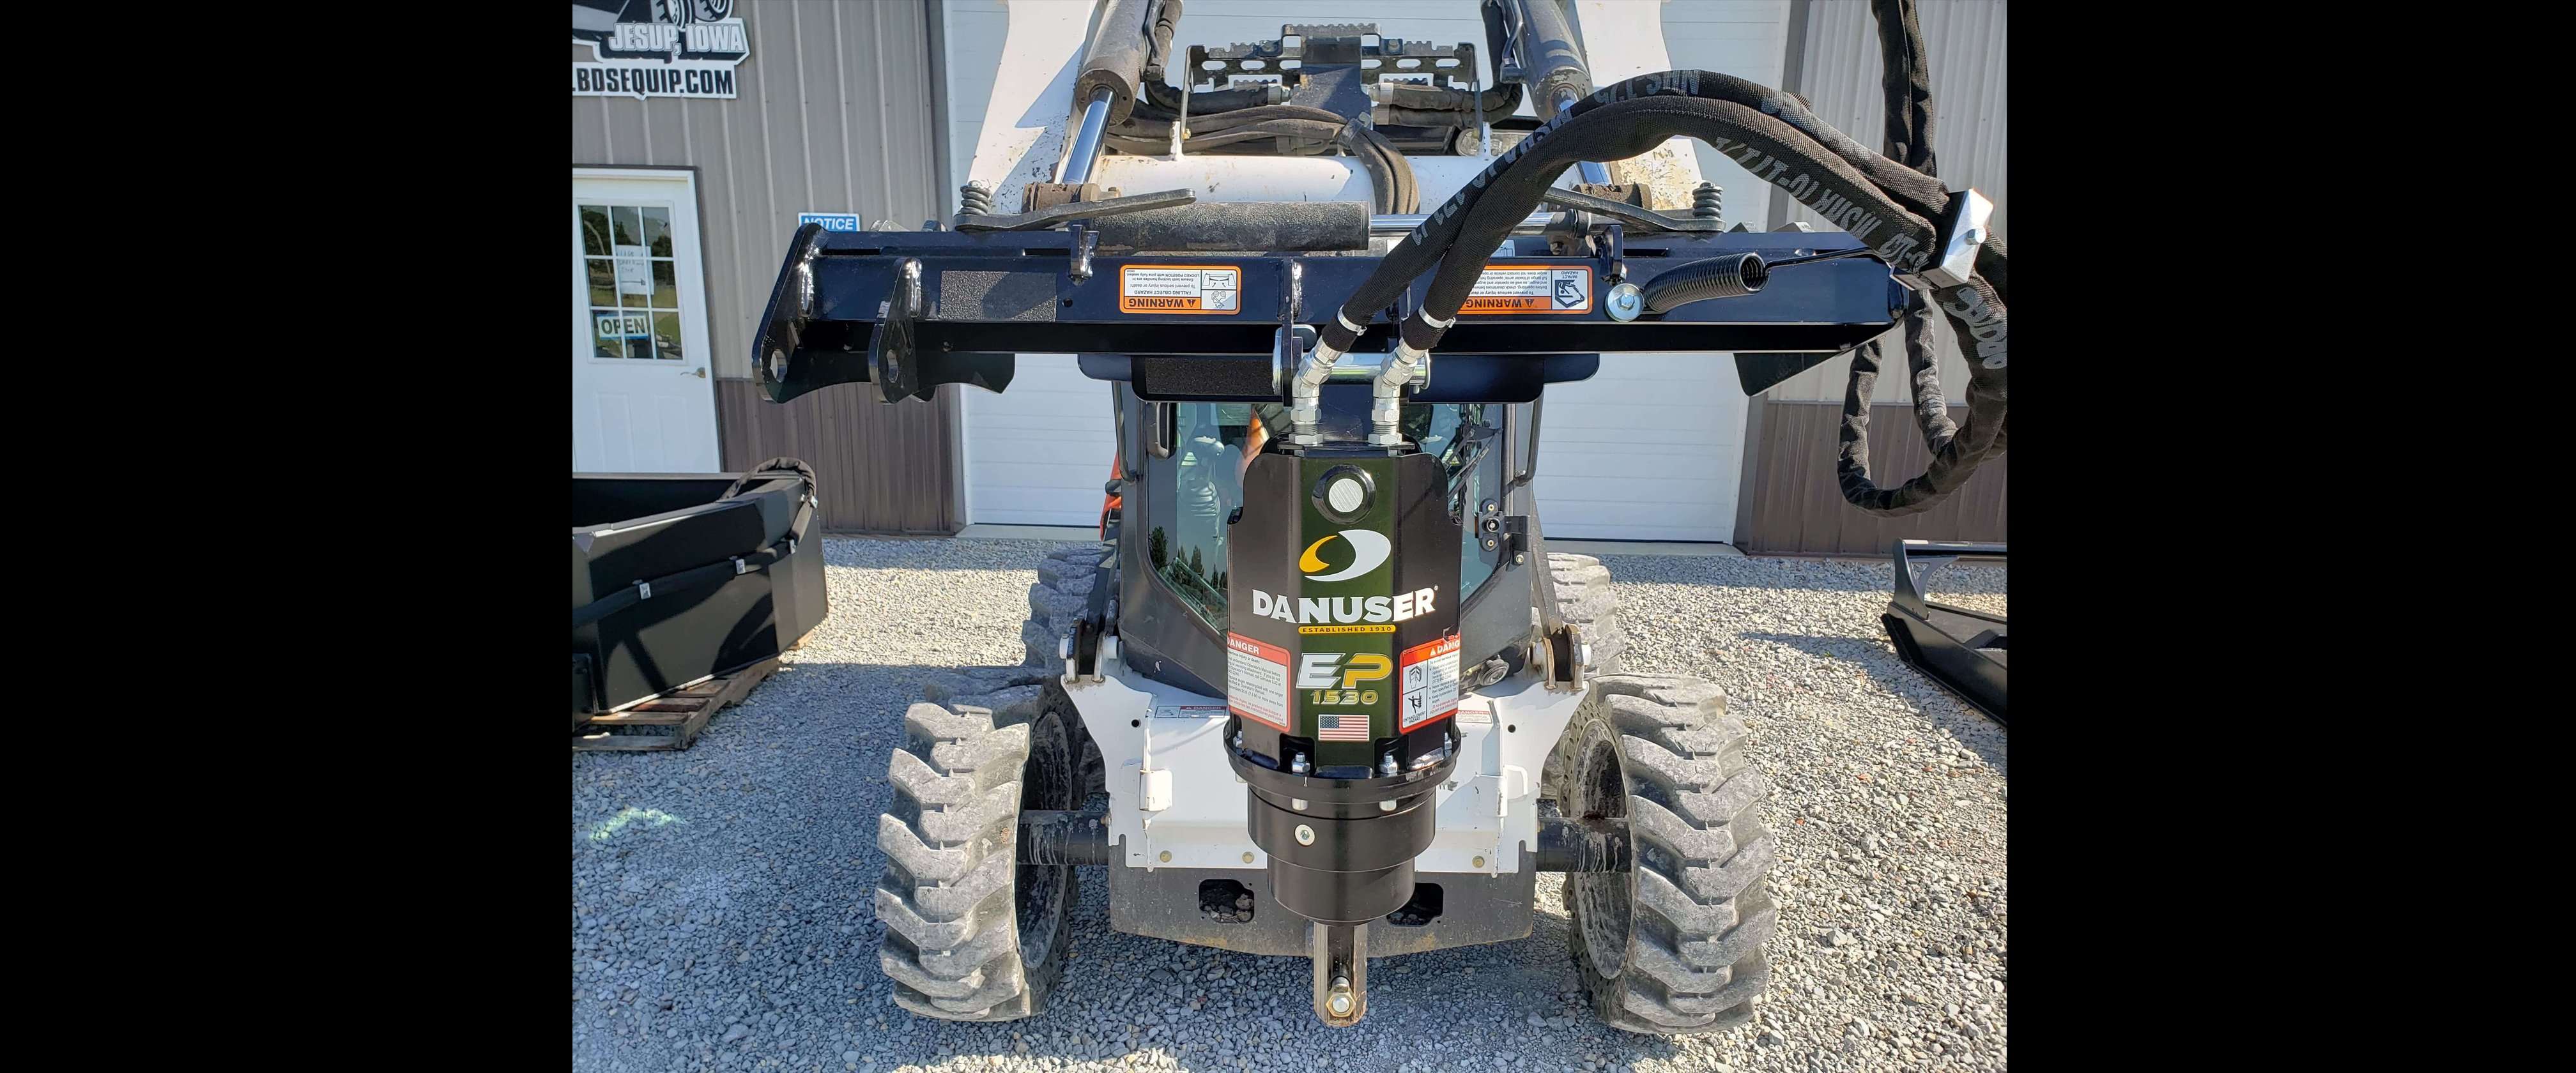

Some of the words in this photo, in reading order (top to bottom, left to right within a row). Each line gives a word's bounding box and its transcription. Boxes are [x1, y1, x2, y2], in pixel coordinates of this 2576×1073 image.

[609, 22, 682, 56] JESUP,
[686, 23, 746, 52] IOWA
[1129, 299, 1184, 307] WARNING
[1466, 299, 1522, 307] WARNING
[601, 319, 646, 334] OPEN
[1252, 587, 1435, 624] DANUSER
[1296, 652, 1393, 689] EP
[1310, 689, 1379, 705] 1530
[1404, 711, 1425, 722] ENTANGLEMENT
